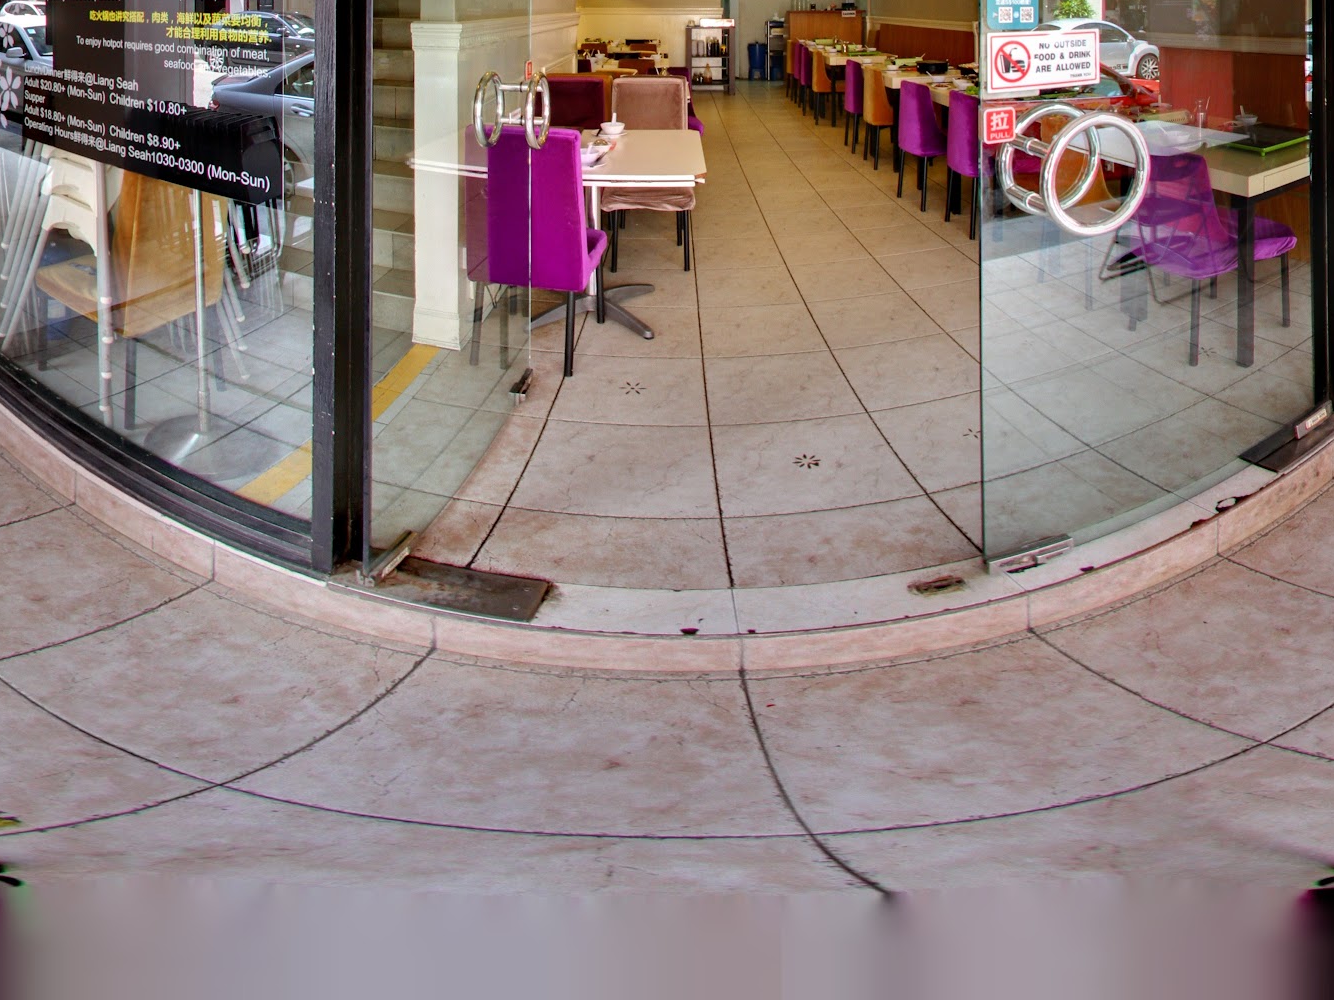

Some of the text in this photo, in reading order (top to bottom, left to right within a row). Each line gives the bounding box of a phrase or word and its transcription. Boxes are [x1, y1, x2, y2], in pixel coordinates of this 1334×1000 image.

[76, 35, 269, 62] To enjoy hotpot requires good combination of meat,
[1054, 39, 1087, 49] OUTSIDE
[1034, 53, 1055, 62] FOOD
[1069, 50, 1091, 59] DRINK
[1036, 61, 1091, 73] ARE ALLOWED
[116, 77, 139, 92] Seah
[24, 76, 187, 116] Adult $20.80+ (Mon-Sun) Children $10.80+
[24, 89, 46, 104] Supper
[24, 103, 181, 151] Adult $18.80+ (Mon-Sun) Children $8.90+
[990, 112, 1010, 131] 拉
[989, 131, 1010, 140] PULL
[24, 116, 54, 136] Operating
[207, 164, 270, 193] (Mon-Sun)
